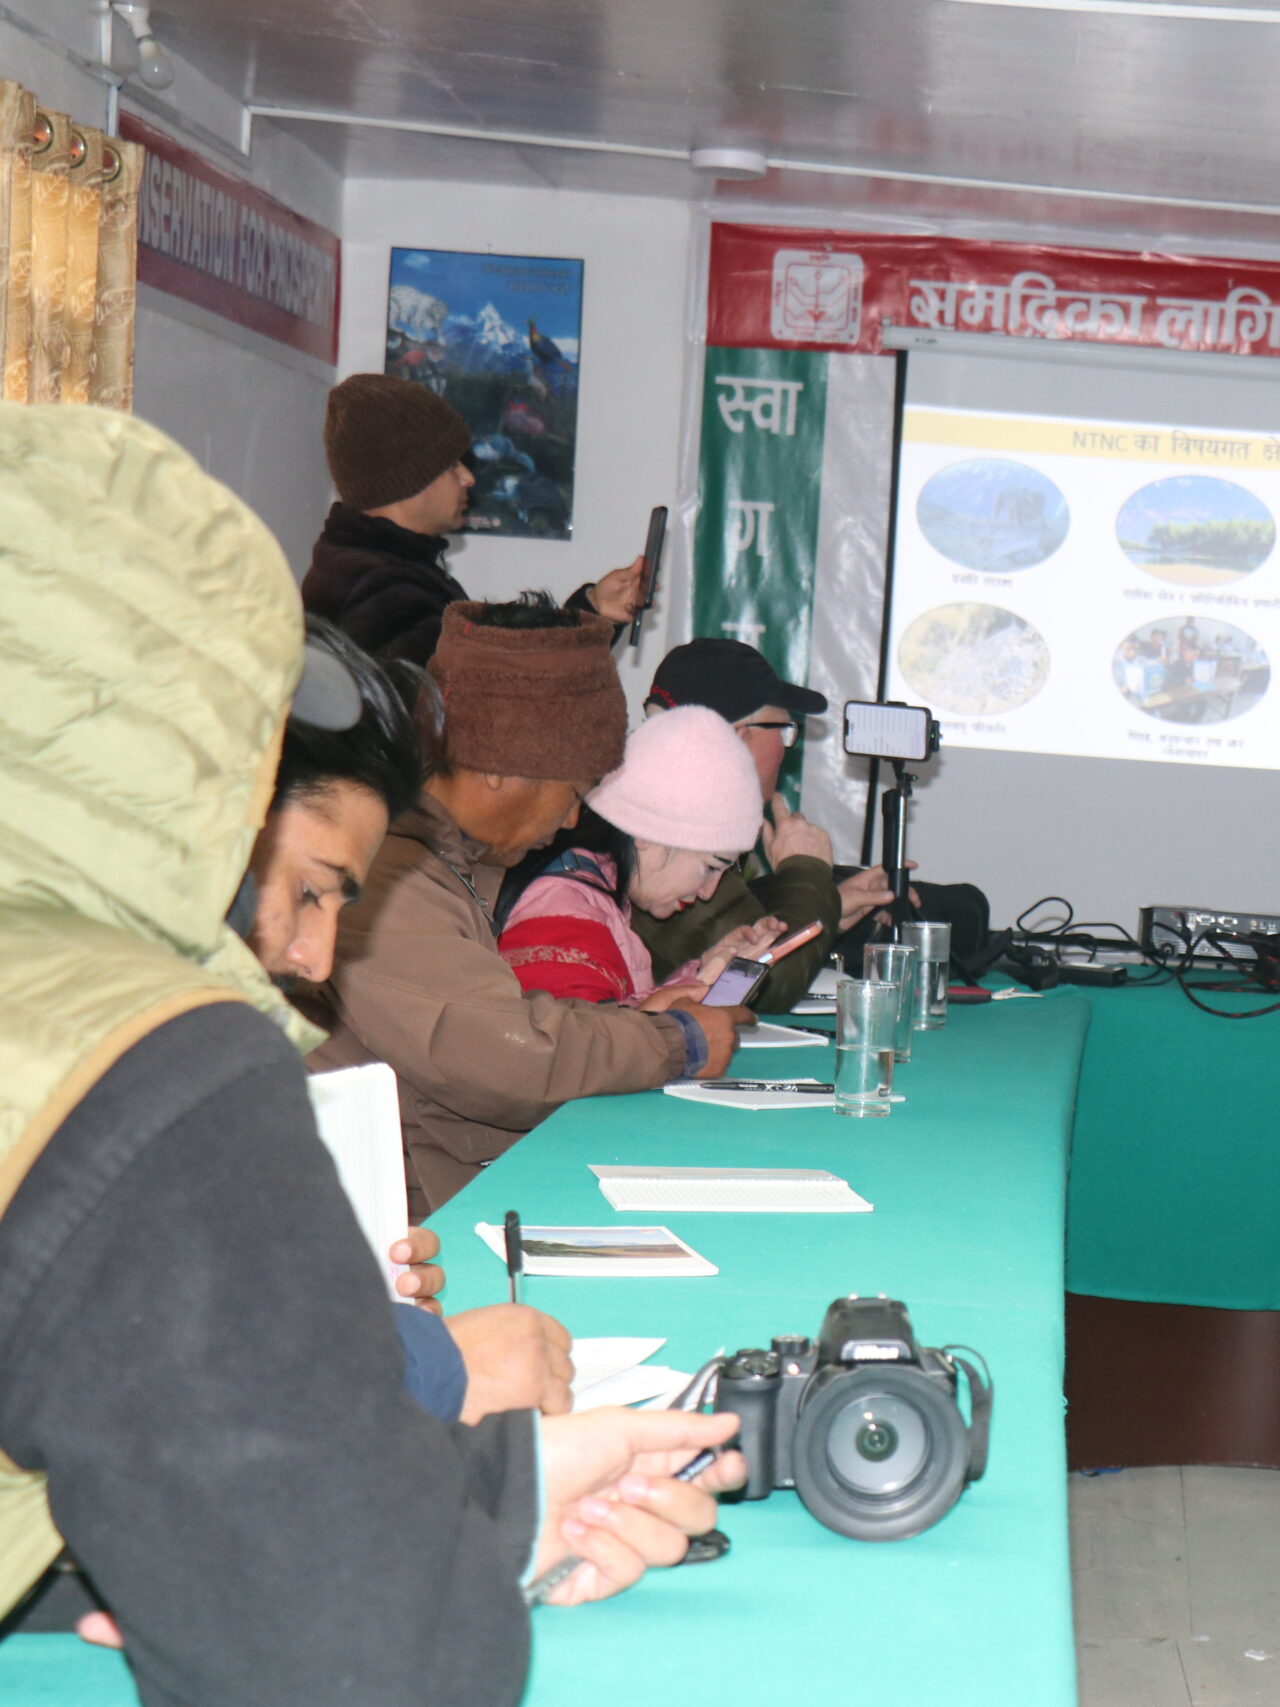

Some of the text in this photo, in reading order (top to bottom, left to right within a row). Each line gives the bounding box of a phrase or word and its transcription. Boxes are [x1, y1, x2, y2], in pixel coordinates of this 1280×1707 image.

[238, 204, 267, 299] FOR
[1072, 431, 1128, 452] NTNC
[1133, 433, 1163, 454] का
